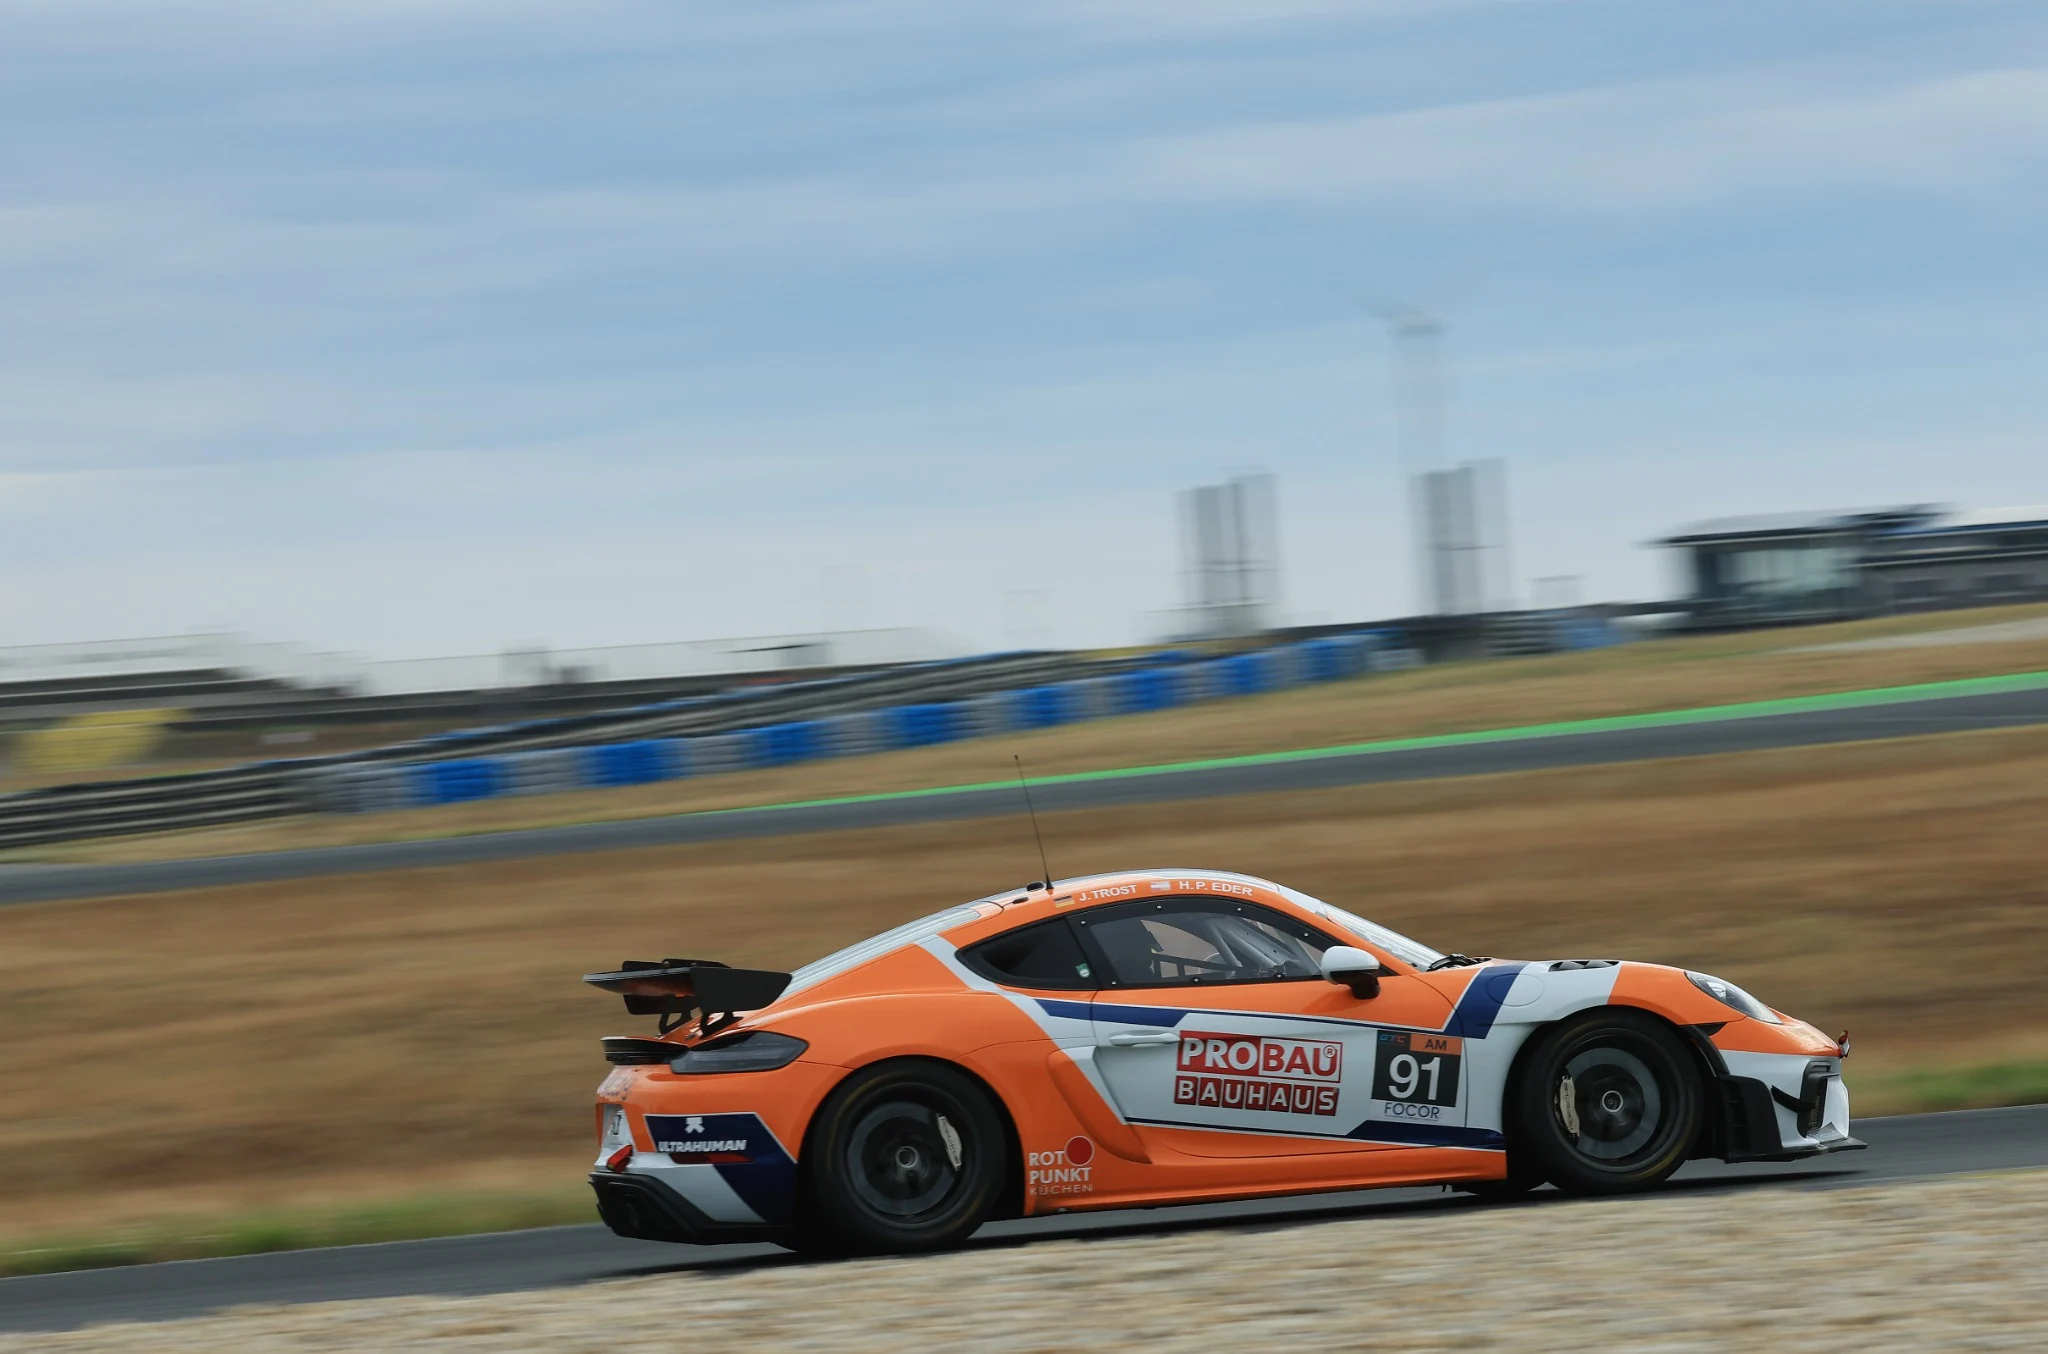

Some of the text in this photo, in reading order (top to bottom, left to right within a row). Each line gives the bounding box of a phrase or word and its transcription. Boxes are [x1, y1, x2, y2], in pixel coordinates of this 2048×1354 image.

[1212, 882, 1253, 896] EDER
[1425, 1039, 1447, 1051] AM
[1388, 1053, 1441, 1101] 91
[1178, 1079, 1336, 1111] BAUHAUS
[1384, 1102, 1440, 1119] FOCOR
[658, 1139, 747, 1153] ULTRAHUMAN
[1028, 1150, 1065, 1167] ROT
[1029, 1167, 1092, 1185] PUNKT
